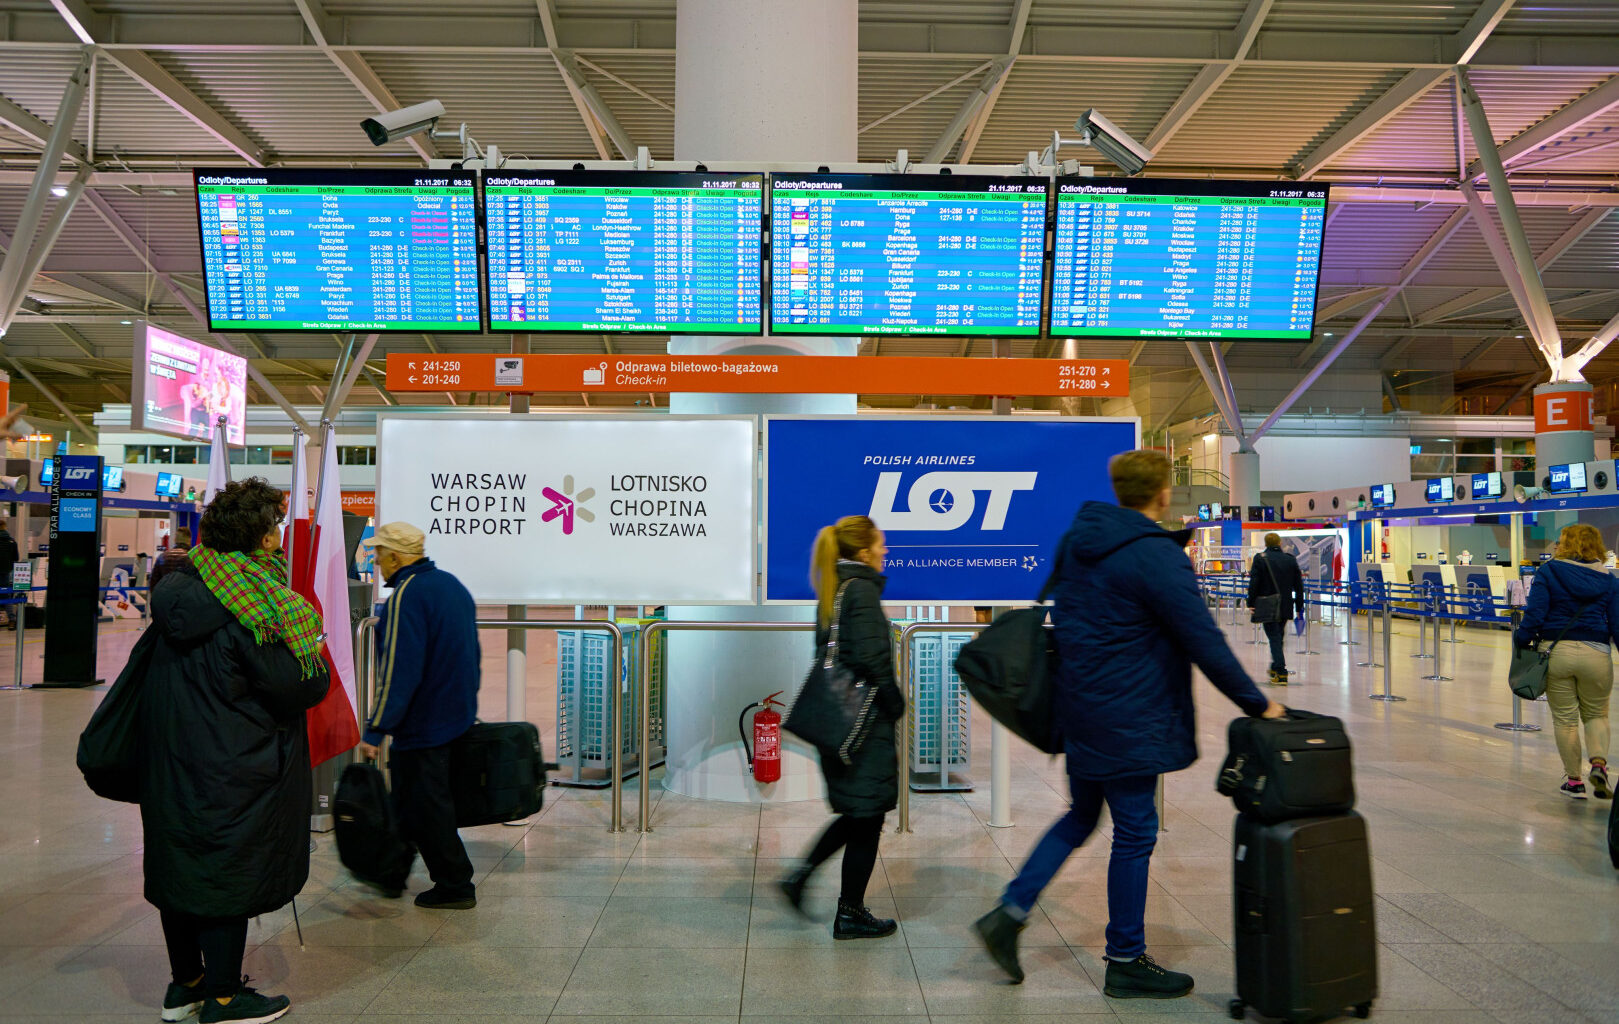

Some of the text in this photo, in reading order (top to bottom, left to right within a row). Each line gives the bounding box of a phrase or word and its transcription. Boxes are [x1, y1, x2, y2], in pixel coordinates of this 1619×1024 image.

[199, 177, 268, 185] Odloty/Departures
[487, 178, 555, 186] Odloty/Departures
[775, 181, 843, 189] Odloty/Departures
[604, 188, 632, 196] Do/Przez
[1060, 185, 1127, 194] Odloty/Departures
[891, 192, 918, 200] Do/Przez
[1174, 196, 1201, 204] Do/Przez
[423, 361, 460, 371] 241-250
[616, 361, 778, 374] Odprawa biletowo-bagażowa
[1059, 366, 1096, 376] 251-270
[423, 375, 460, 384] 201-240
[616, 375, 666, 385] Check-in
[1059, 379, 1096, 389] 271-280
[1547, 398, 1568, 425] E
[864, 455, 975, 465] POLISH AIRLINES
[64, 469, 95, 479] LOT
[1552, 473, 1568, 482] LOT
[431, 474, 526, 489] WARSAW
[611, 475, 707, 492] LOTNISKO
[1474, 480, 1487, 489] LOT
[1429, 485, 1440, 493] LOT
[50, 466, 61, 539] STAR ALLIANCE
[430, 496, 526, 512] CHOPIN
[868, 471, 1038, 531] LOT
[610, 500, 707, 516] CHOPINA
[429, 518, 526, 535] AIRPORT
[610, 523, 707, 537] WARSZAWA
[882, 558, 1017, 568] TAR ALLIANCE MEMBER
